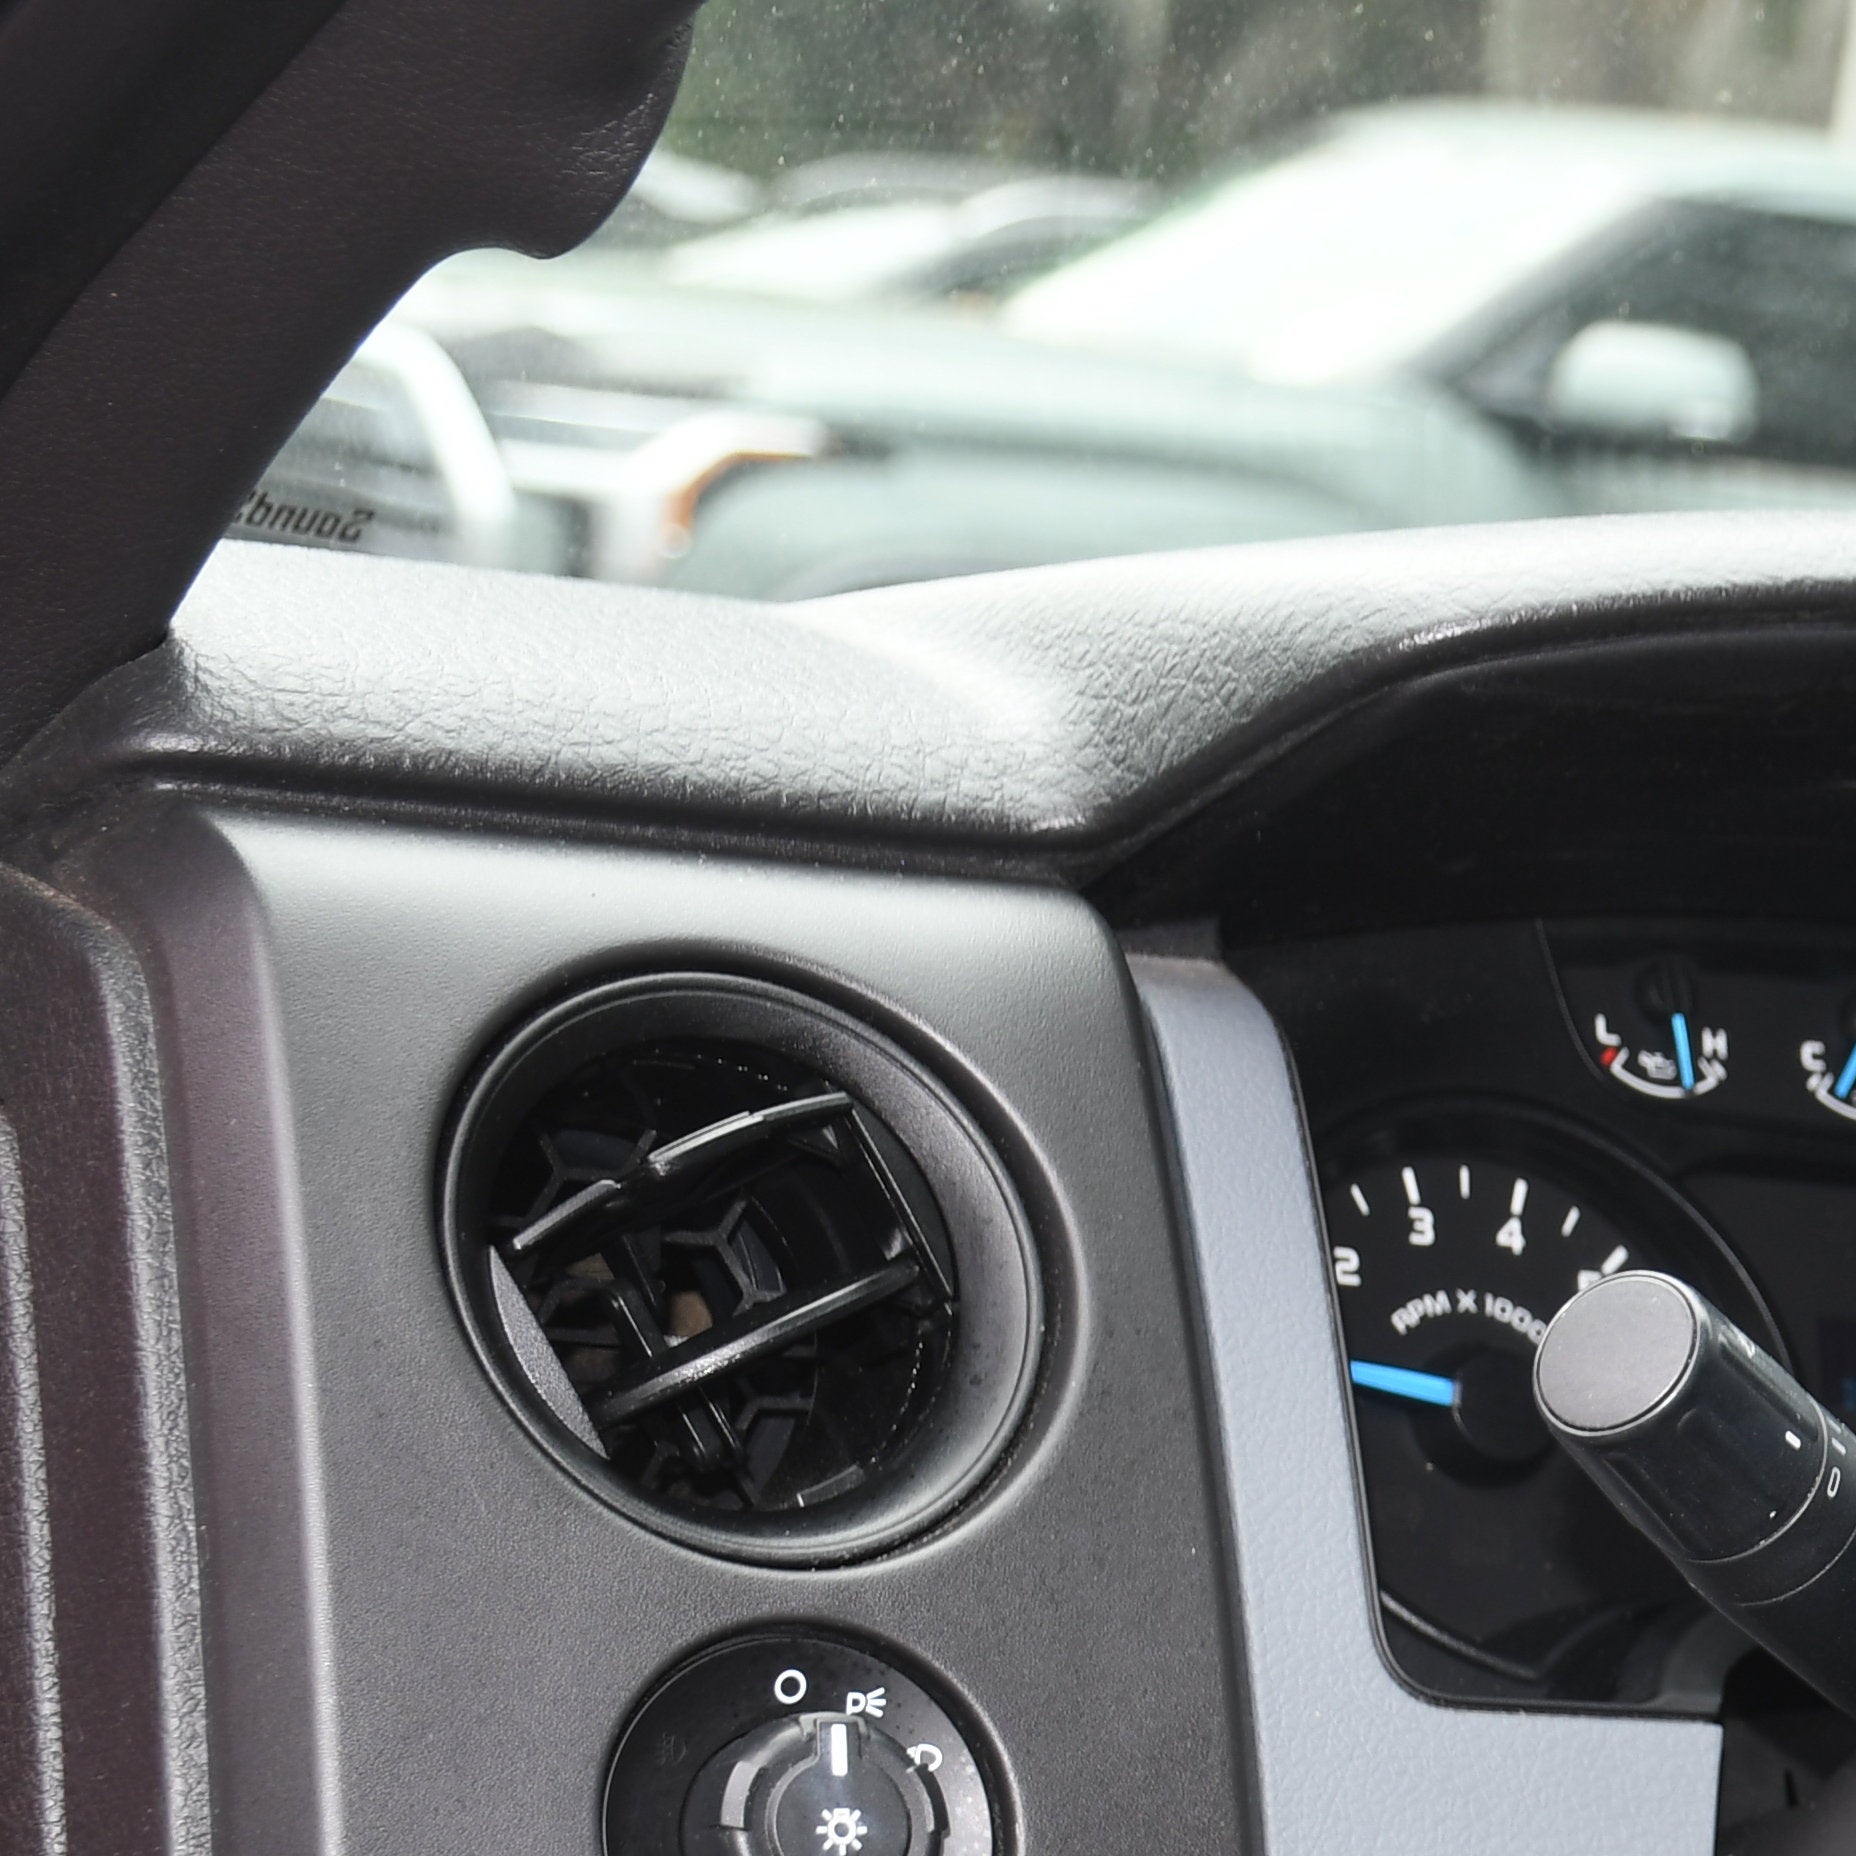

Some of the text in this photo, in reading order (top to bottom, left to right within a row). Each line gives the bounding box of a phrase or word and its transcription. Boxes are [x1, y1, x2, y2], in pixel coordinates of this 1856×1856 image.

[1594, 1012, 1622, 1047] L
[1701, 1026, 1728, 1061] H
[1800, 1040, 1827, 1072] C
[1407, 1206, 1436, 1247] 3
[1495, 1216, 1527, 1256] 4
[1333, 1245, 1363, 1287] 2
[1389, 1289, 1452, 1337] RPM
[1455, 1287, 1480, 1314] X
